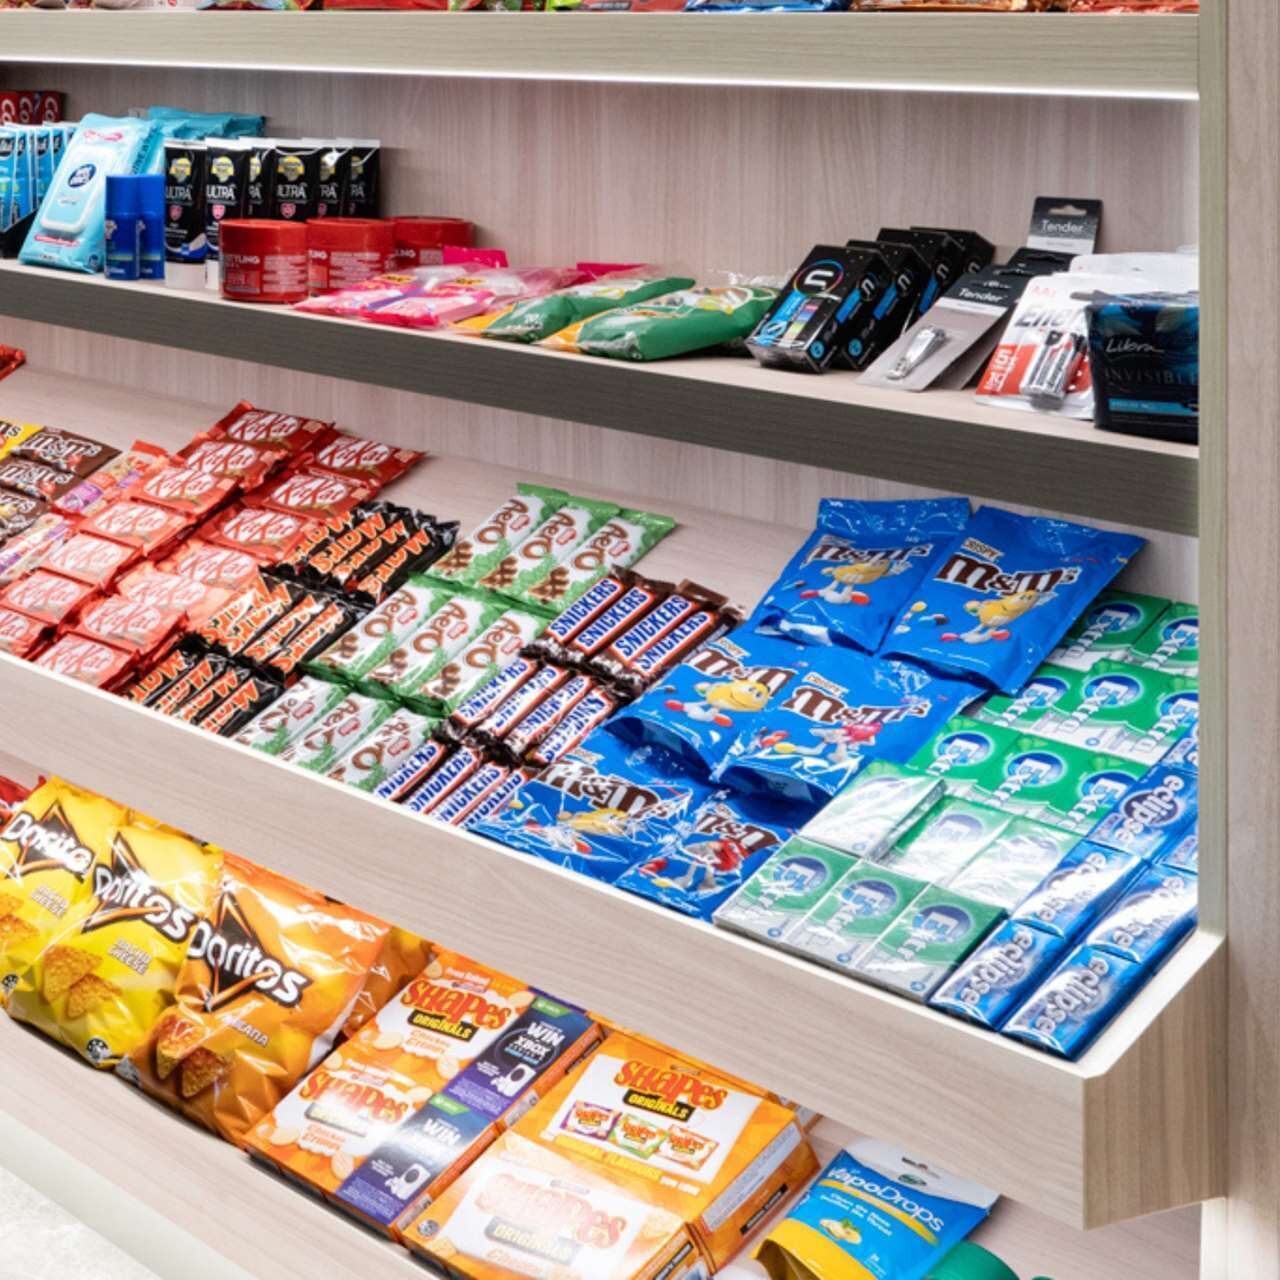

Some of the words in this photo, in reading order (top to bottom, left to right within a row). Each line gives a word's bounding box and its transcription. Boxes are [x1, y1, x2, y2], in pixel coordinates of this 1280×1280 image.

[206, 184, 236, 200] ULTRA
[1040, 219, 1085, 234] Tender
[958, 286, 1004, 304] Tender
[1105, 337, 1165, 354] Libra
[26, 433, 103, 457] m&m's
[228, 412, 298, 442] KitKat
[188, 441, 258, 472] KitKat
[318, 436, 390, 468] KitKat
[144, 467, 214, 498] KitKat
[272, 476, 345, 506] KitKat
[95, 502, 167, 533] KitKat
[223, 509, 298, 541] KitKat
[477, 498, 530, 544] Aero
[522, 510, 578, 561] Aero
[572, 522, 629, 571] Aero
[8, 573, 82, 606] KitKat
[934, 551, 1083, 597] m&m's
[85, 604, 160, 636] KitKat
[364, 588, 419, 640] Aero
[413, 599, 469, 655] Aero
[549, 578, 620, 638] SNICKERS
[578, 588, 649, 650] SNICKERS
[613, 596, 689, 657] SNICKERS
[465, 615, 522, 668] Aero
[640, 610, 710, 672] SNICKERS
[455, 657, 527, 717] SNICKERS
[782, 686, 932, 724] m&m's
[1113, 776, 1185, 845] eclipse
[95, 866, 197, 941] Doritos
[187, 919, 308, 1004] Doritos
[959, 930, 1034, 1008] eclipse
[400, 979, 513, 1030] SHAPES
[1039, 956, 1111, 1037] eclipse
[412, 1013, 474, 1040] ORIGINALS
[525, 1020, 566, 1048] WIN
[613, 1060, 728, 1110] SHAPES
[627, 1093, 690, 1121] ORIGINALS
[423, 1117, 463, 1145] WIN
[827, 1166, 945, 1234] VapoDrops
